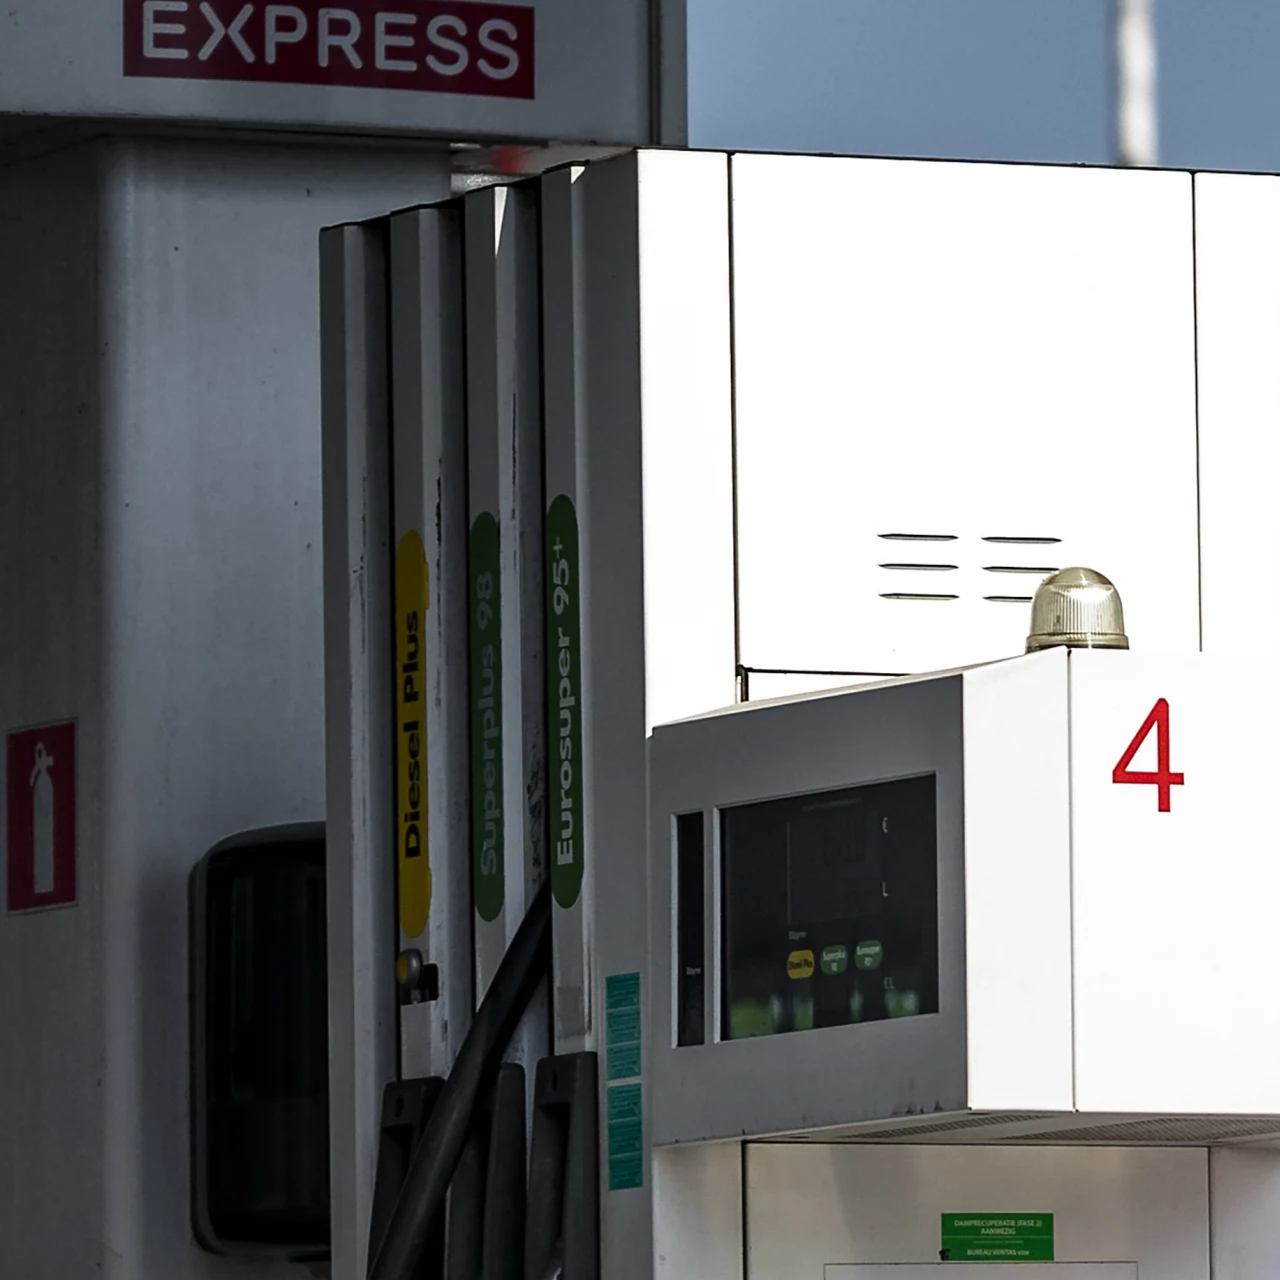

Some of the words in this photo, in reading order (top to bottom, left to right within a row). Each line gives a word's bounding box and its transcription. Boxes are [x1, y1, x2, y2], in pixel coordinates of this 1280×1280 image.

[143, 1, 519, 79] EXPRESS
[477, 569, 493, 630] 98
[552, 535, 569, 616] 95+
[403, 610, 420, 704] Plus
[403, 721, 422, 857] Diesel
[476, 643, 499, 876] Superplus
[557, 628, 576, 865] Eurosuper
[1113, 698, 1185, 813] 4
